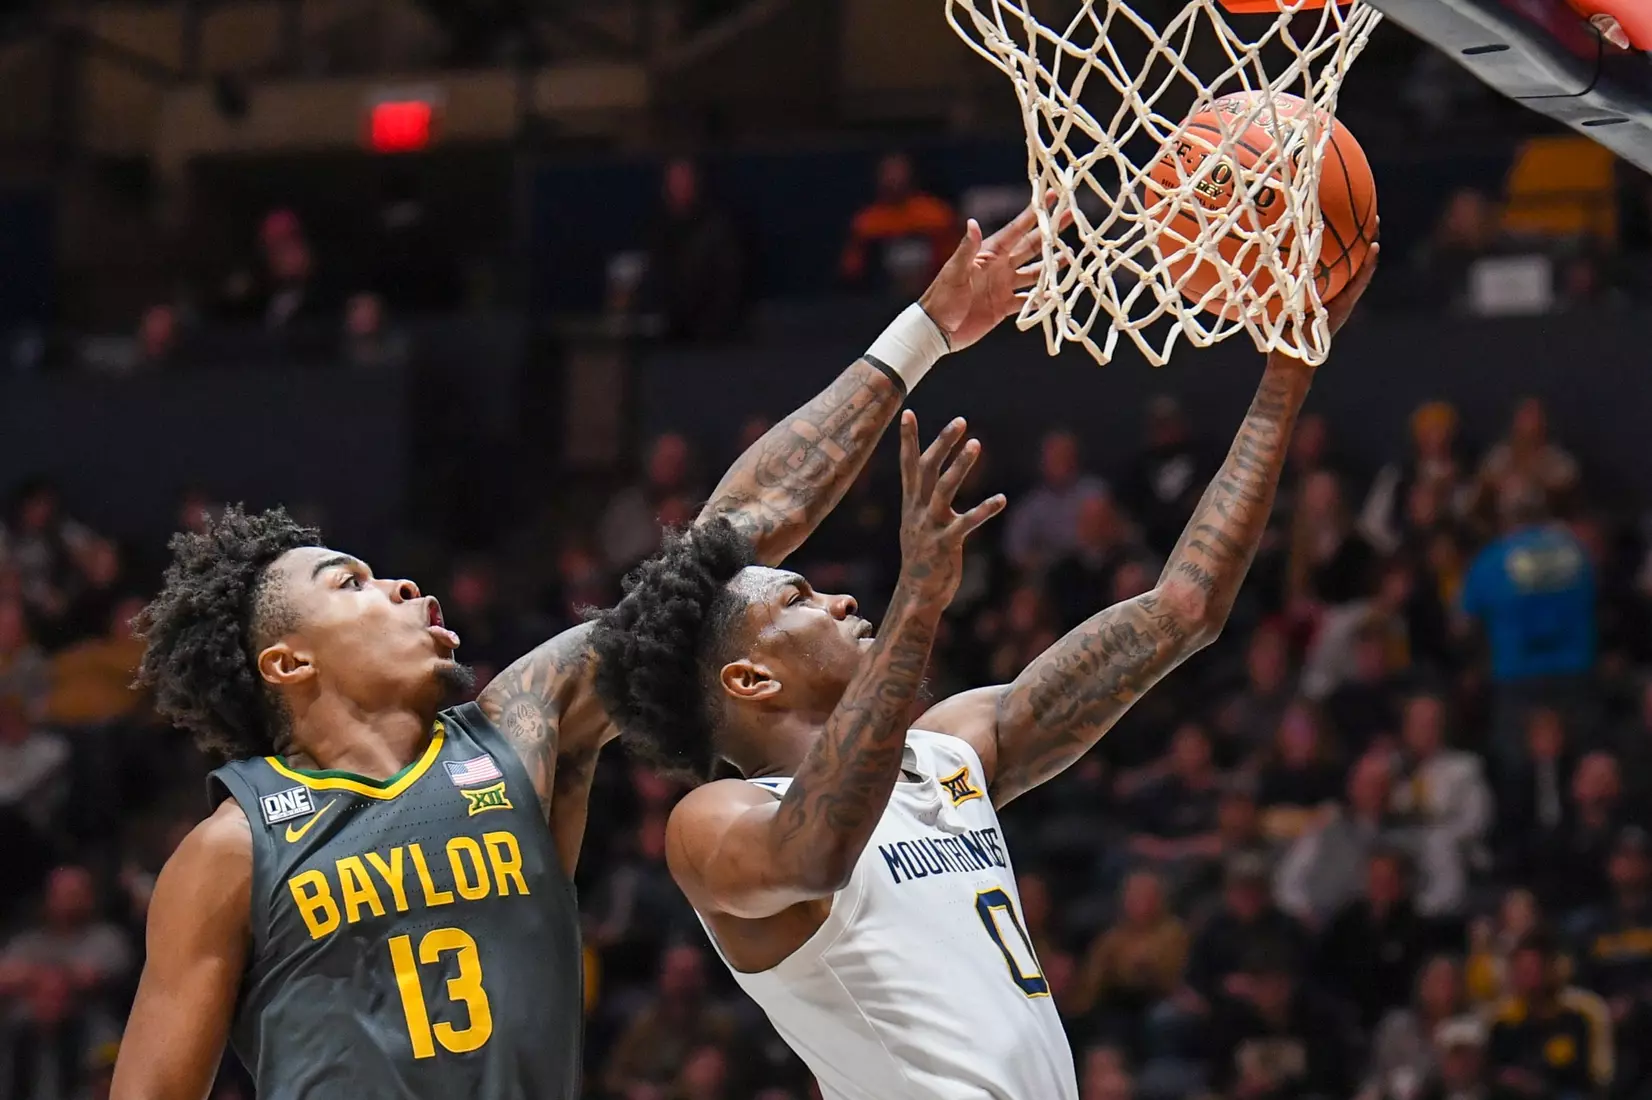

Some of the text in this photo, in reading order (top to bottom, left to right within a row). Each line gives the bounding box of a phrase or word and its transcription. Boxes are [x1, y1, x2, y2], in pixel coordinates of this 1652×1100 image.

[264, 787, 309, 815] ONE
[941, 770, 978, 803] XII
[288, 831, 531, 940] BAYLOR
[388, 927, 493, 1059] 13
[974, 884, 1050, 999] 0
